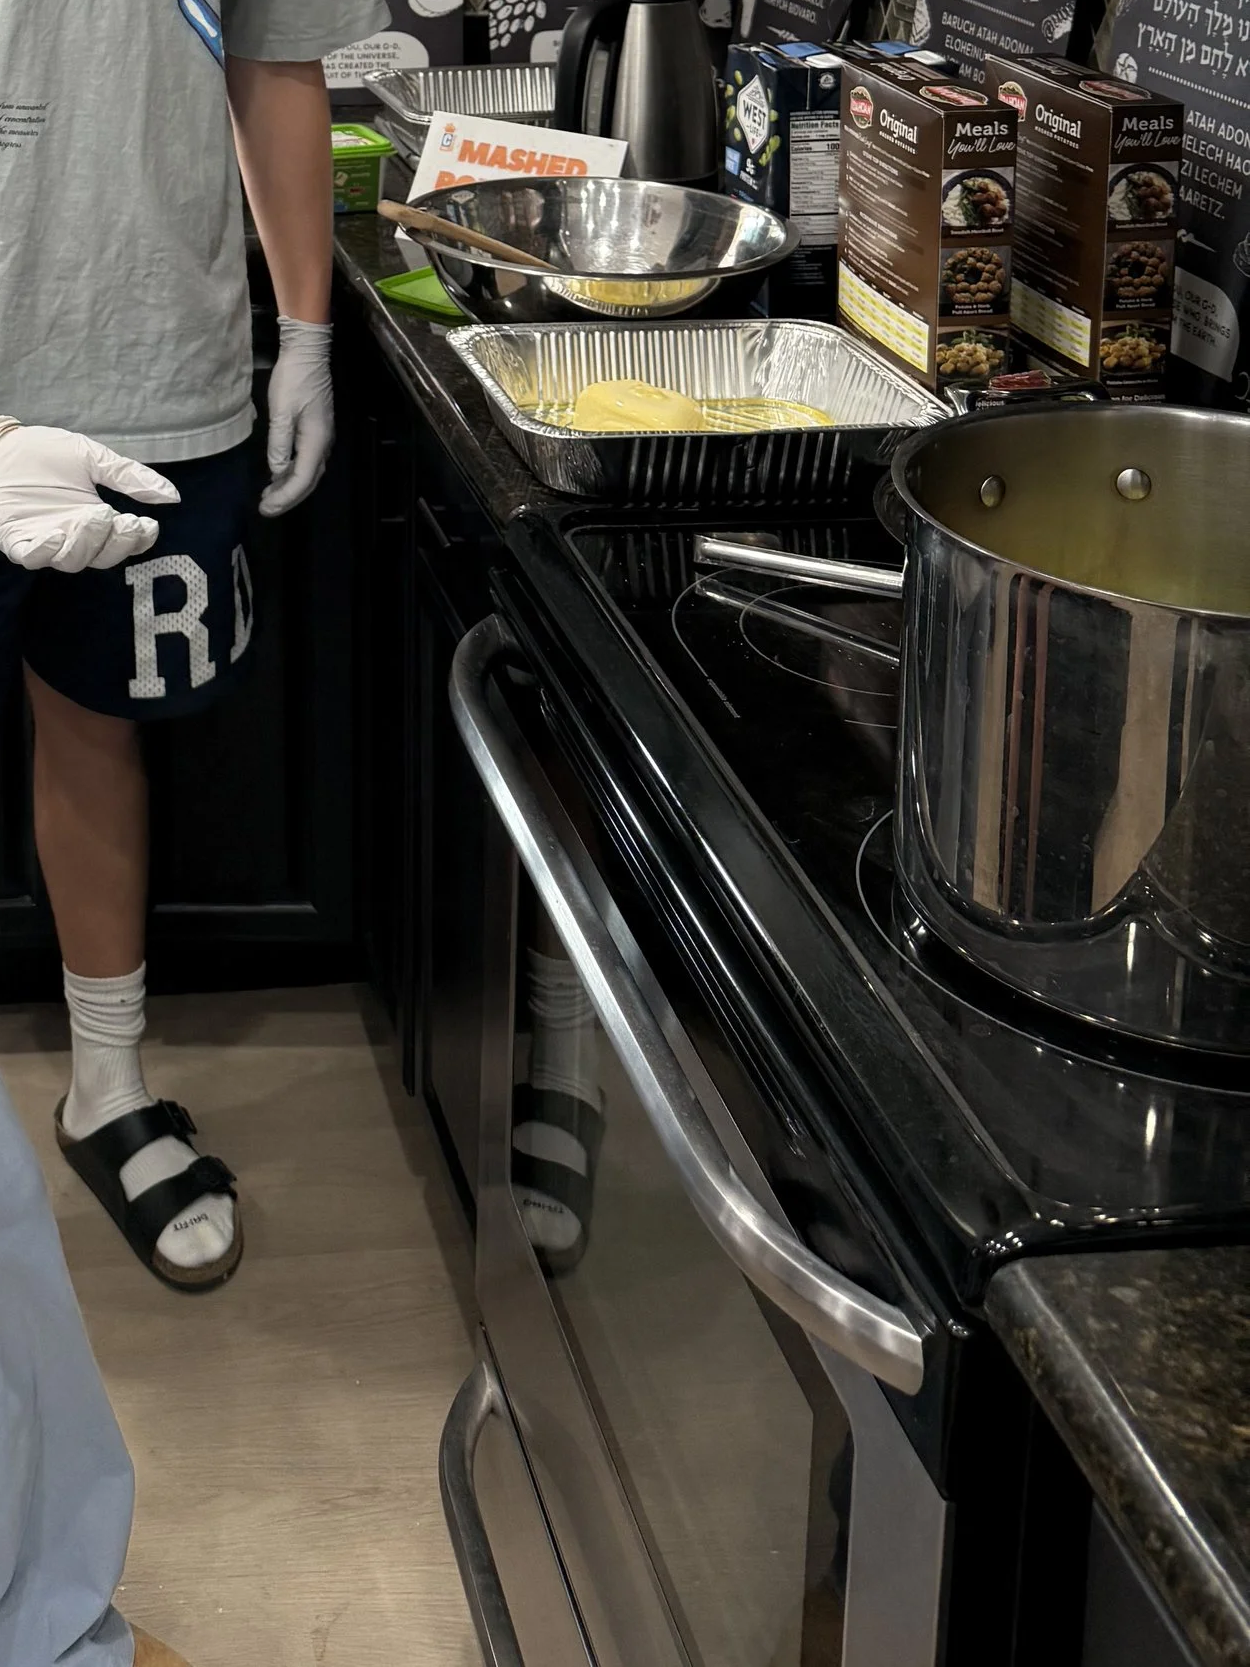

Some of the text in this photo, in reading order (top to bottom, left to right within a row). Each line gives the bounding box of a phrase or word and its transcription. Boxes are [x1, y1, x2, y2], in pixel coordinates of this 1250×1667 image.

[941, 12, 976, 35] BARUCH
[976, 26, 998, 45] ATAH
[742, 99, 767, 131] WEST
[879, 108, 918, 144] Original
[954, 121, 1009, 137] Meals
[1035, 103, 1081, 139] Original
[1121, 115, 1175, 132] Meals
[1186, 109, 1250, 148] ATAH ADON
[457, 139, 588, 176] MASHED
[947, 137, 1016, 160] You'll Love
[1114, 131, 1181, 154] You'll Love
[1194, 165, 1243, 200] LECHEM
